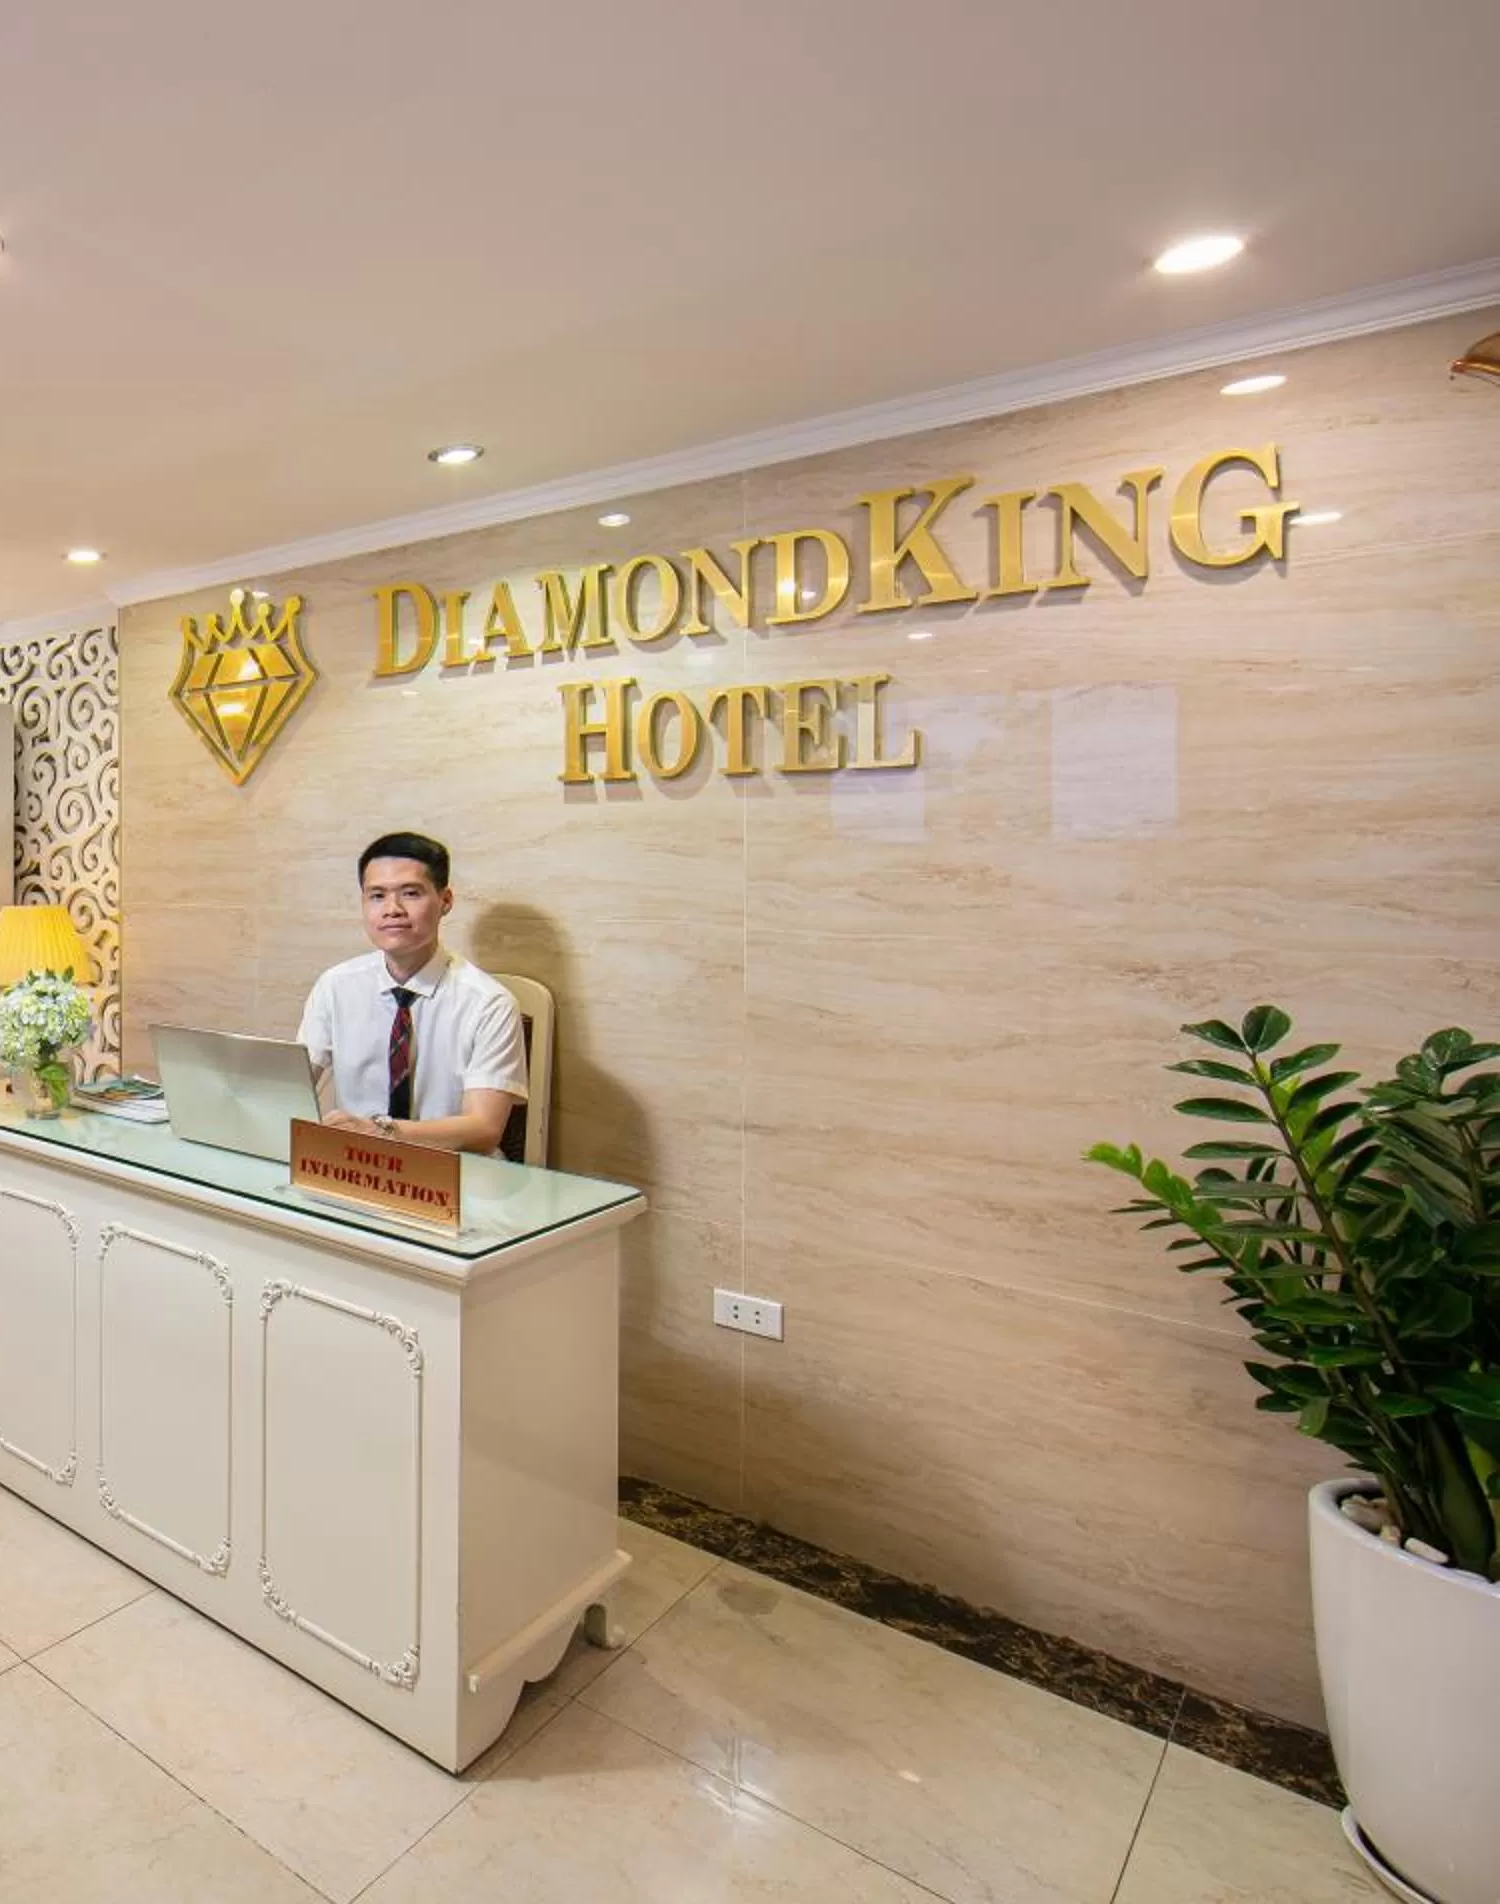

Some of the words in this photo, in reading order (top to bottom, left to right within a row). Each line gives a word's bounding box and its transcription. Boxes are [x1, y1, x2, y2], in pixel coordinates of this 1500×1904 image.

[558, 673, 921, 783] HOTEL
[300, 1158, 451, 1207] INFORMATION
[345, 1145, 405, 1173] TOUR
